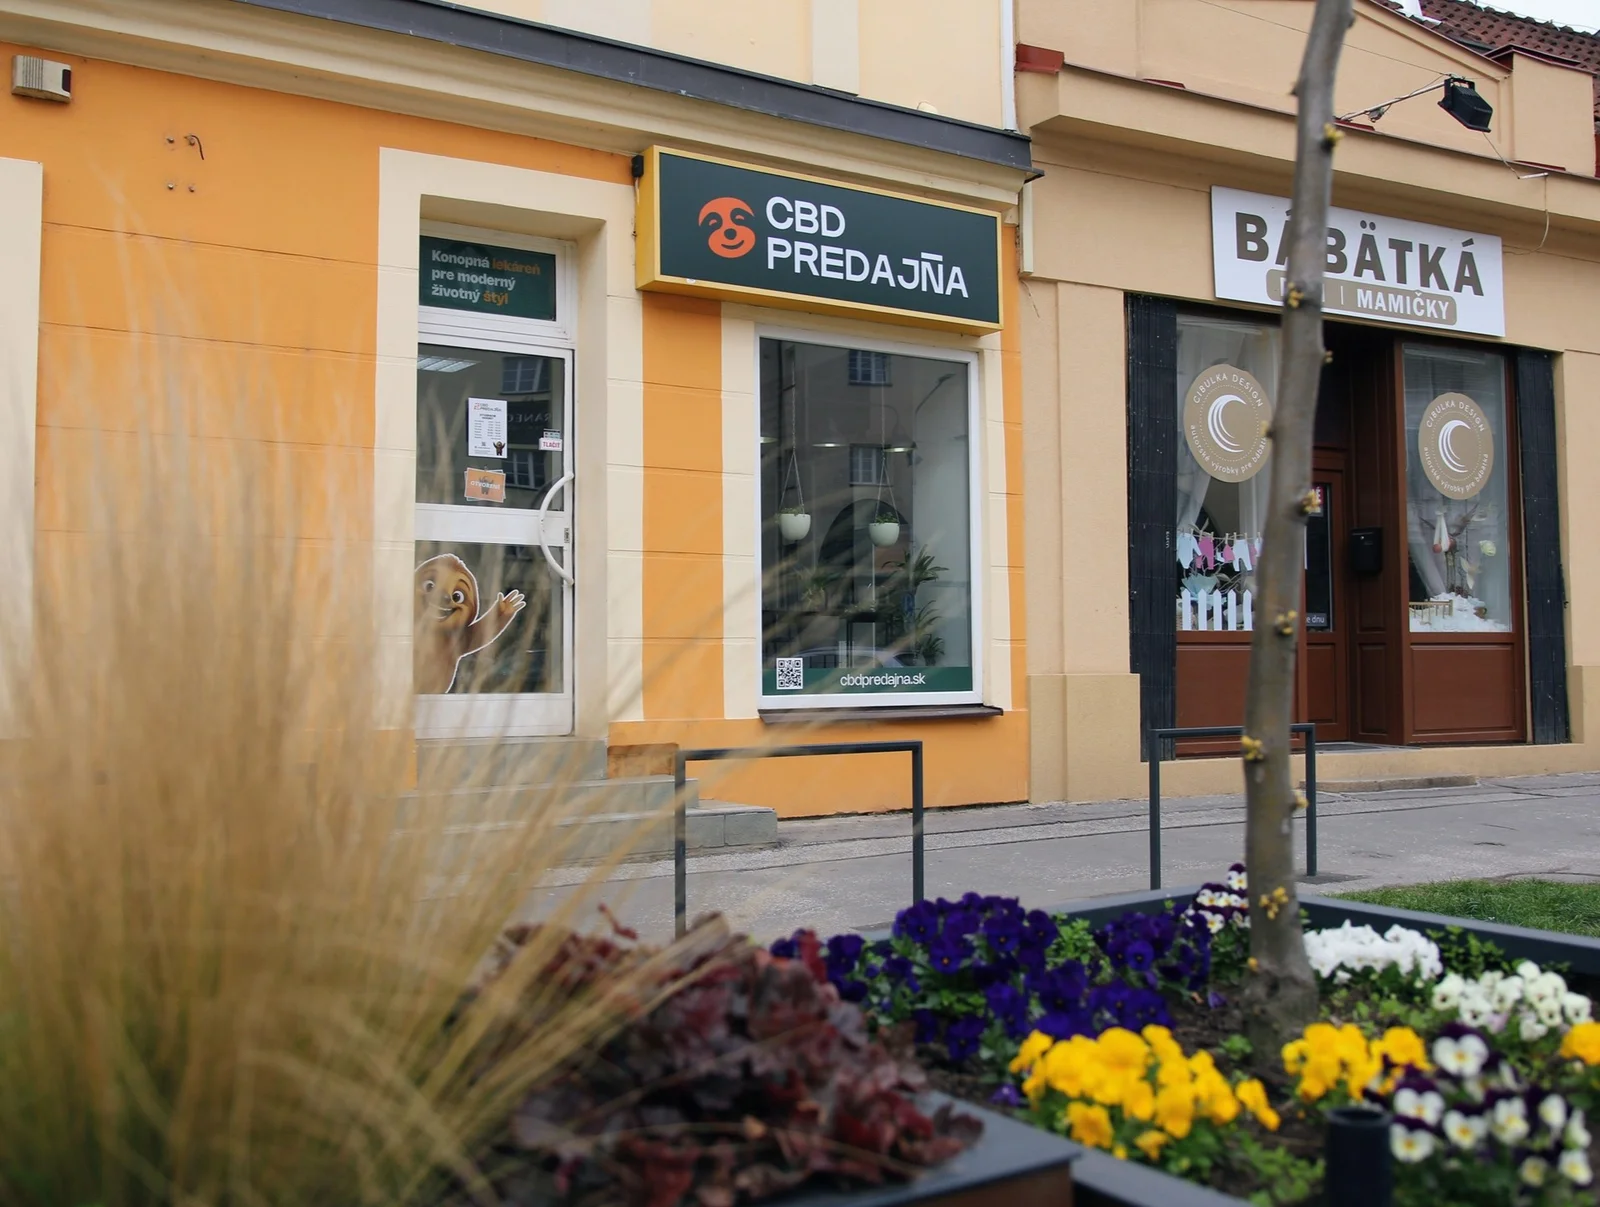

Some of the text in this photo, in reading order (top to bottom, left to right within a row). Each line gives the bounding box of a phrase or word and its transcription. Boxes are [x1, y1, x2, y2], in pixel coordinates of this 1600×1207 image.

[766, 196, 846, 237] CBD
[431, 250, 490, 269] Konopná
[431, 269, 516, 291] pre moderný
[431, 284, 509, 306] životný štýl
[1356, 288, 1449, 320] MAMIČKY
[1193, 373, 1264, 407] CIBULKA DESIGN
[1426, 400, 1485, 432] CIBULKA DESIGN
[1211, 461, 1239, 475] výrobky
[1241, 462, 1252, 474] pre
[1441, 480, 1464, 493] výrobky
[1312, 614, 1325, 624] dnu
[840, 673, 926, 688] cbdpredajna.sk
